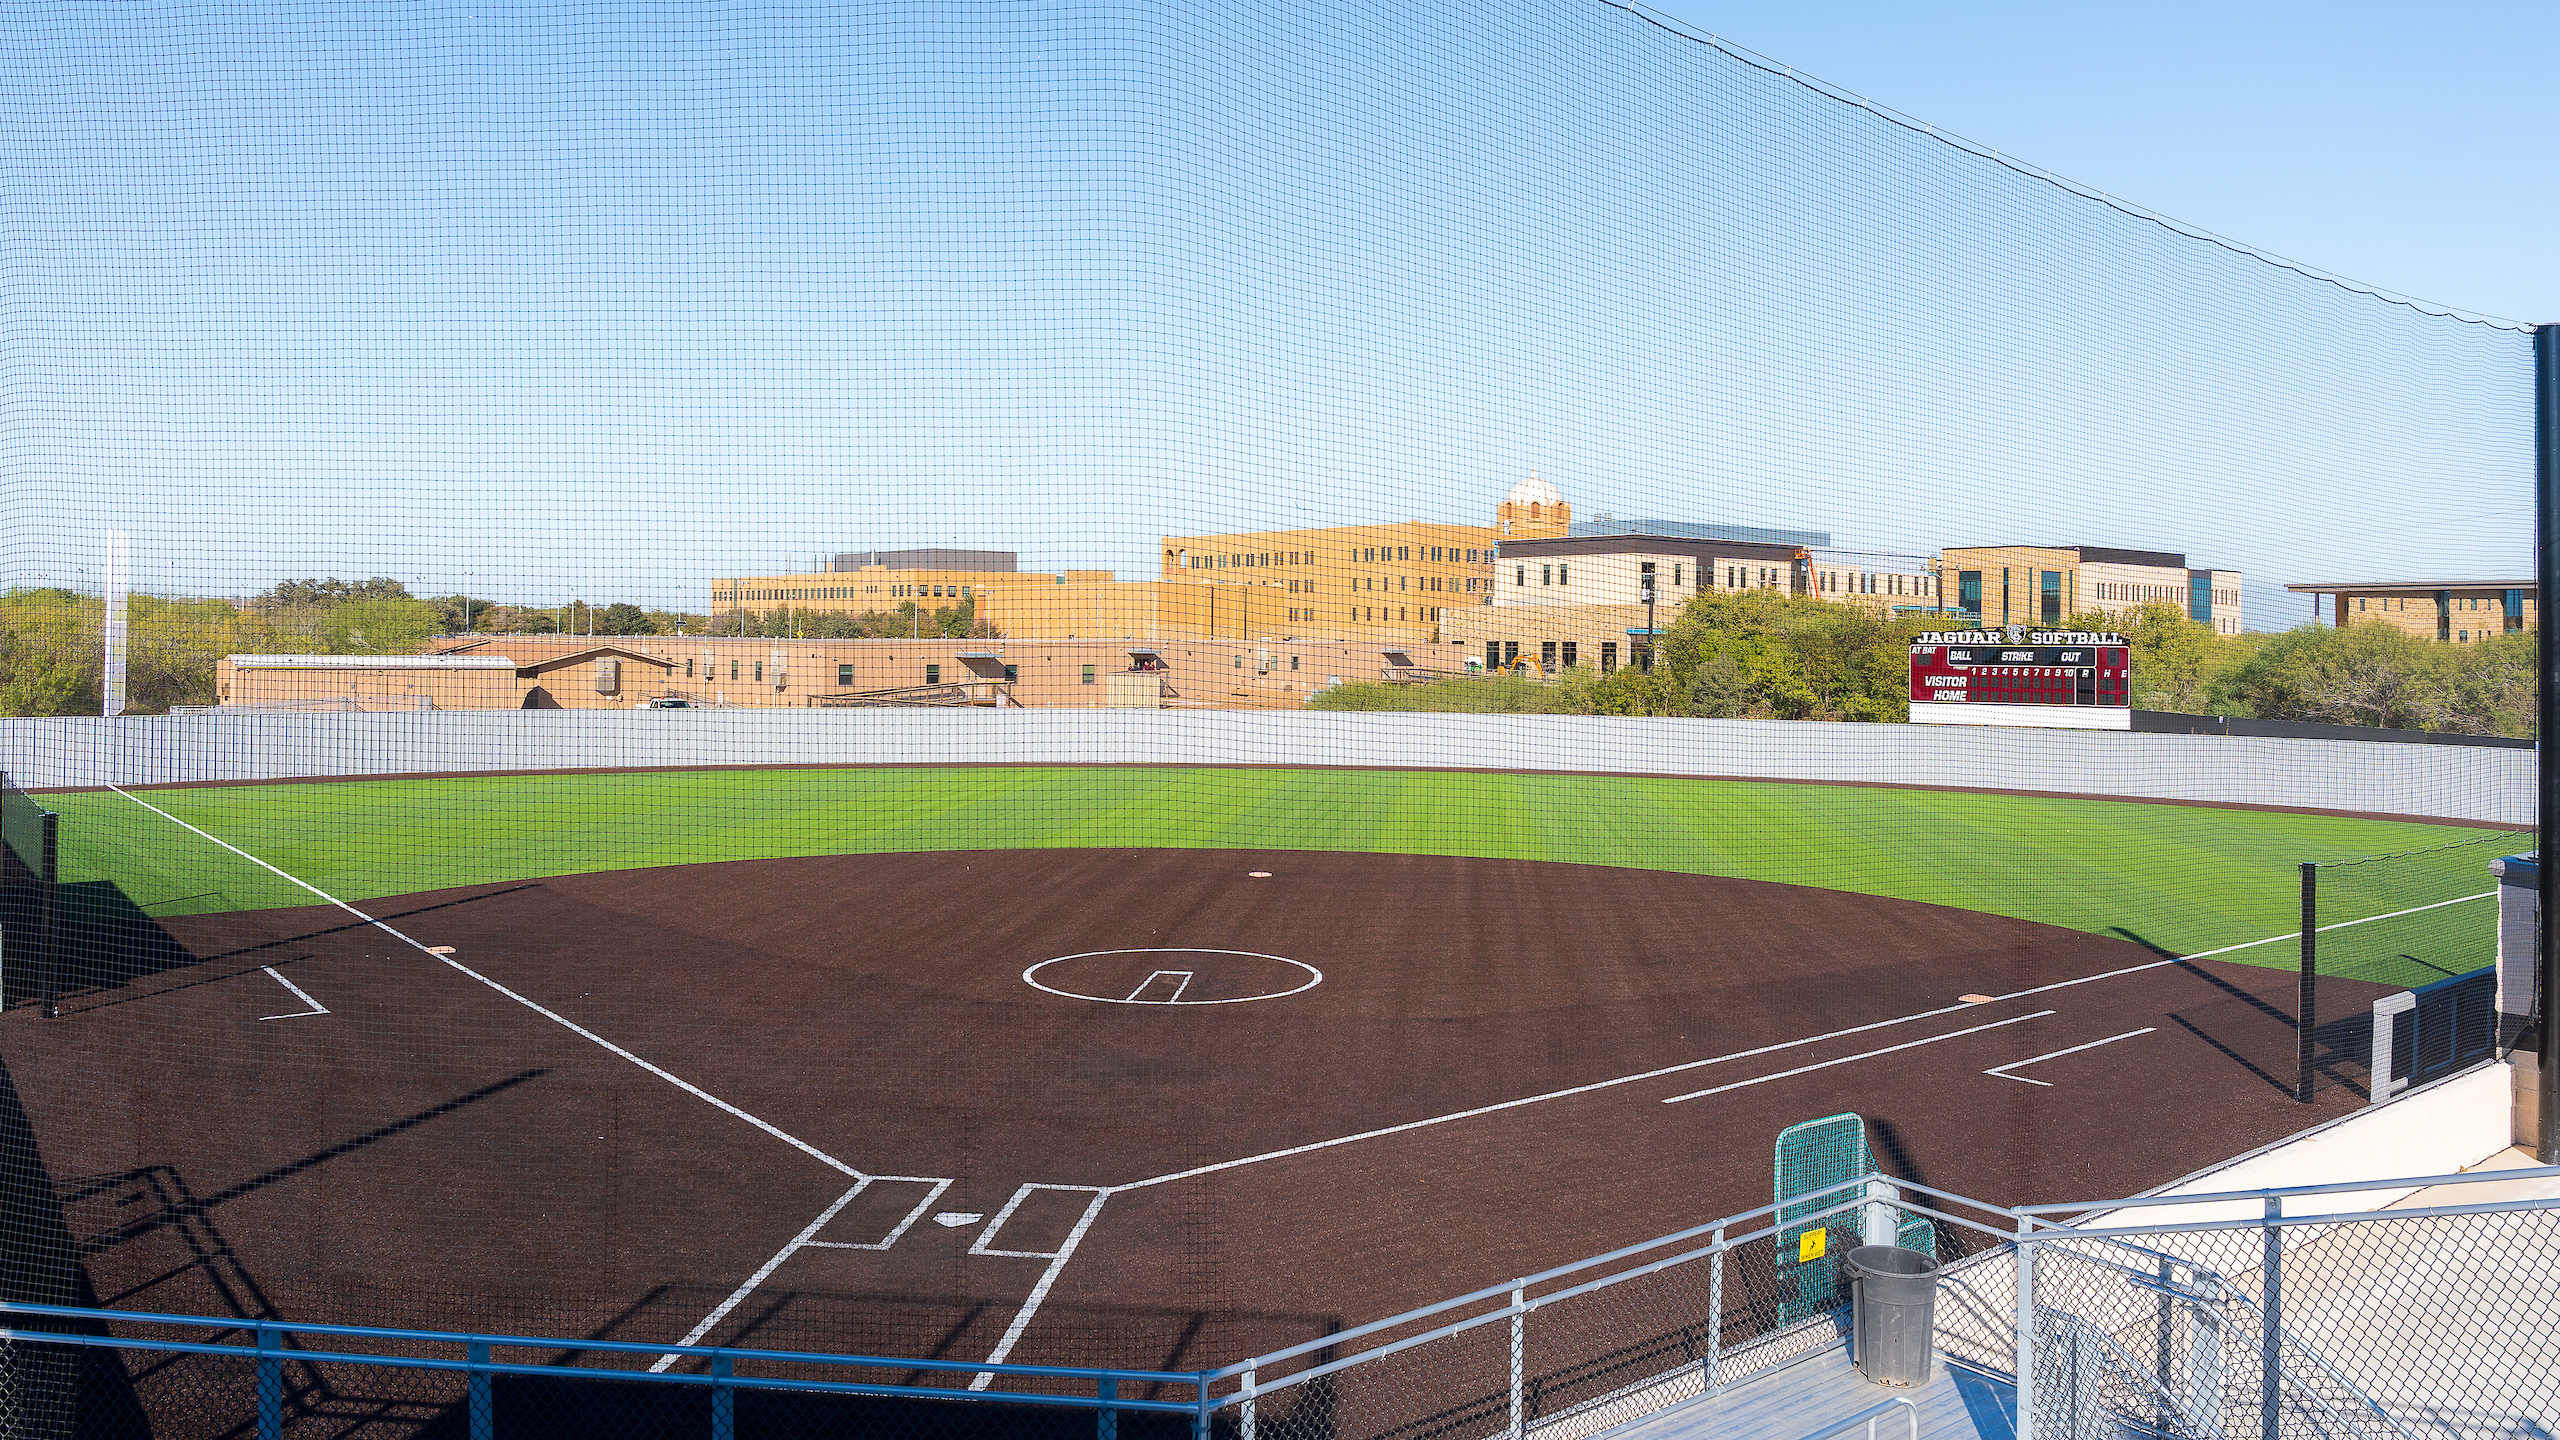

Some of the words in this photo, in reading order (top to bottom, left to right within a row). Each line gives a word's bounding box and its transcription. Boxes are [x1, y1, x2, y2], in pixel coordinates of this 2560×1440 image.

[1917, 631, 2002, 644] JAGUAR
[2031, 631, 2123, 645] SOFTBALL
[1911, 646, 1922, 654] AT
[1922, 646, 1937, 654] BAT
[1950, 651, 1972, 661] BALL
[2001, 651, 2034, 661] STRIKE
[2061, 652, 2081, 662] OUT
[1971, 667, 1977, 675] 1
[1981, 667, 1988, 675] 2
[1991, 667, 1998, 676] 3
[2002, 668, 2009, 676] 4
[2012, 668, 2019, 676] 5
[2022, 668, 2029, 676] 6
[2033, 668, 2040, 676] 7
[2044, 668, 2050, 677] 8
[2054, 668, 2061, 677] 9
[2063, 668, 2074, 677] 10
[2081, 669, 2089, 678] R
[2103, 669, 2111, 678] H
[2120, 669, 2127, 678] E
[1924, 676, 1967, 687] VISITOR
[1933, 690, 1967, 701] HOME
[1803, 1230, 1822, 1240] SLIPPERY
[1801, 1252, 1814, 1260] WHEN
